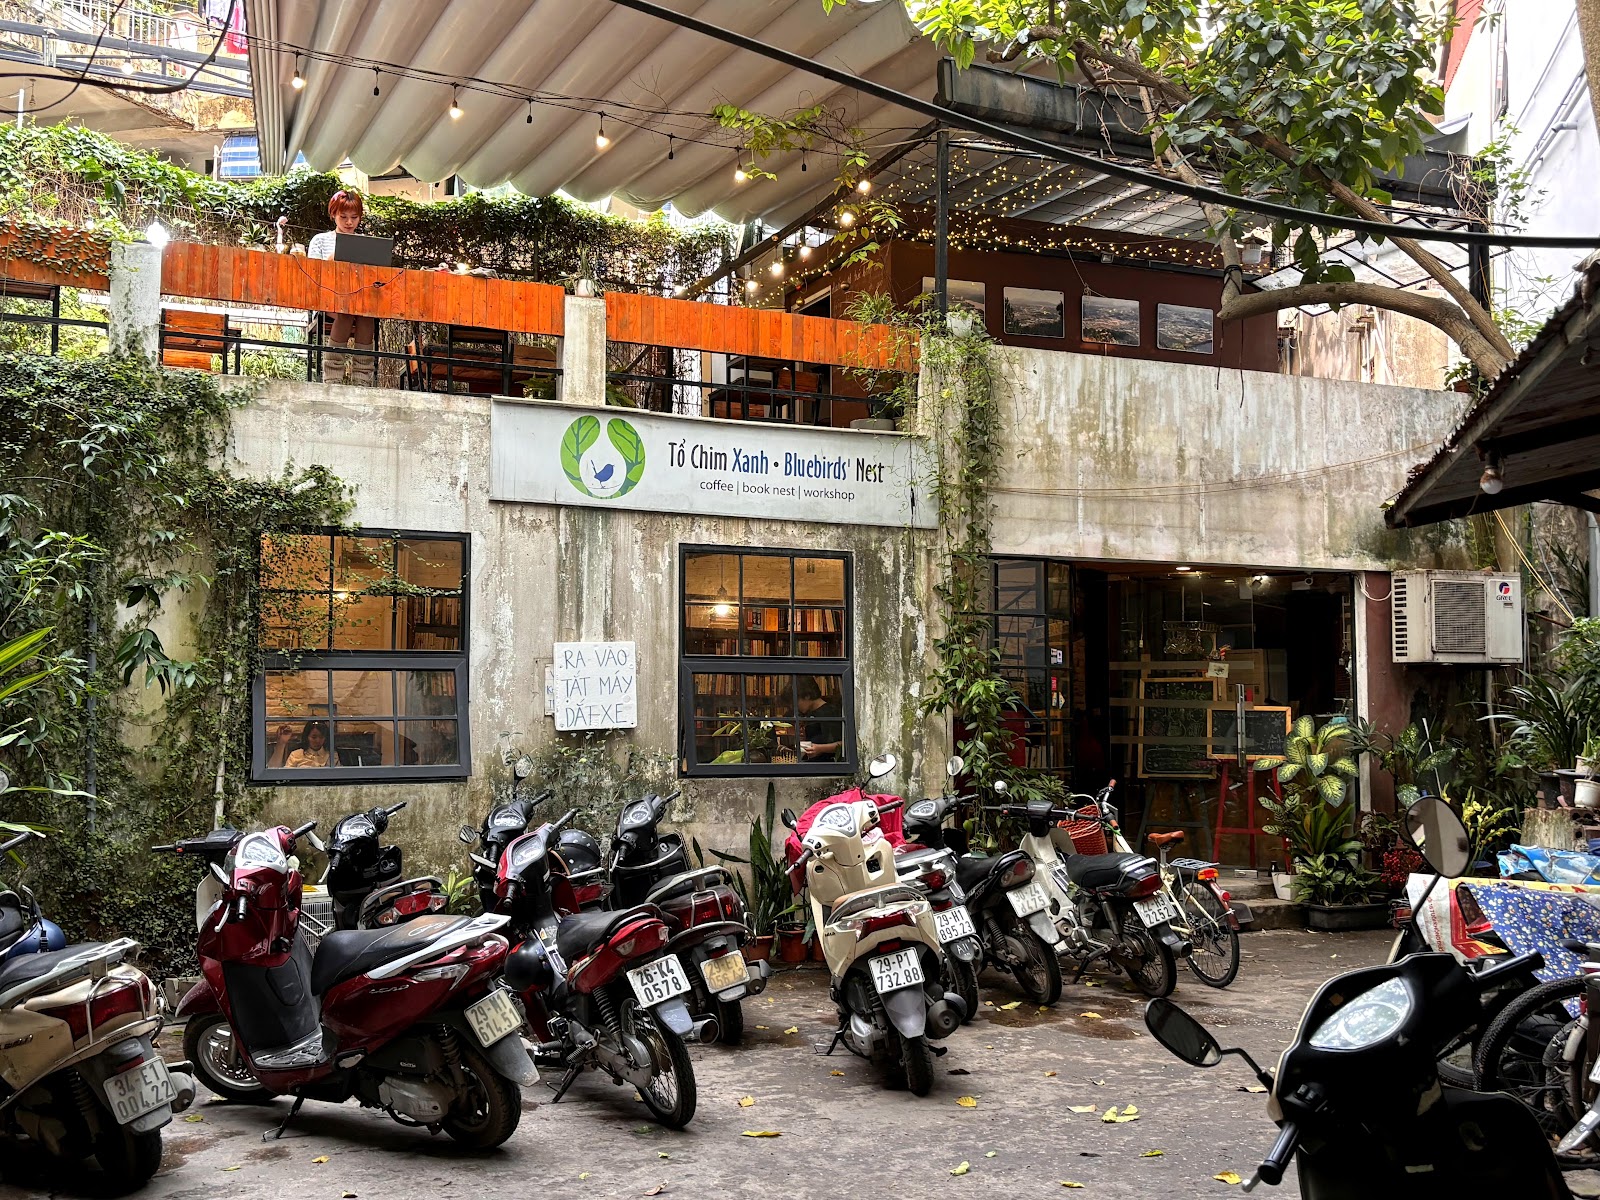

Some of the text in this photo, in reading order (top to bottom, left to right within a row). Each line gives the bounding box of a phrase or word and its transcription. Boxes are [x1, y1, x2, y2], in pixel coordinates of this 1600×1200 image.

[668, 438, 885, 483] Tổ Chim Xanh Bluebirds' Nest
[700, 479, 855, 503] coffee book nest workshop
[564, 649, 586, 670] RA
[599, 669, 633, 696] MÁY
[936, 909, 965, 928] 29-H1
[1145, 906, 1172, 925] 2252
[939, 920, 973, 941] 895.23
[636, 960, 675, 987] 26-K4
[876, 952, 912, 974] 29-P1
[643, 976, 682, 1003] 0578
[876, 967, 920, 991] 732.88
[478, 1007, 520, 1043] 614.51
[114, 1063, 160, 1096] 34-E1
[117, 1080, 174, 1119] 004.22
